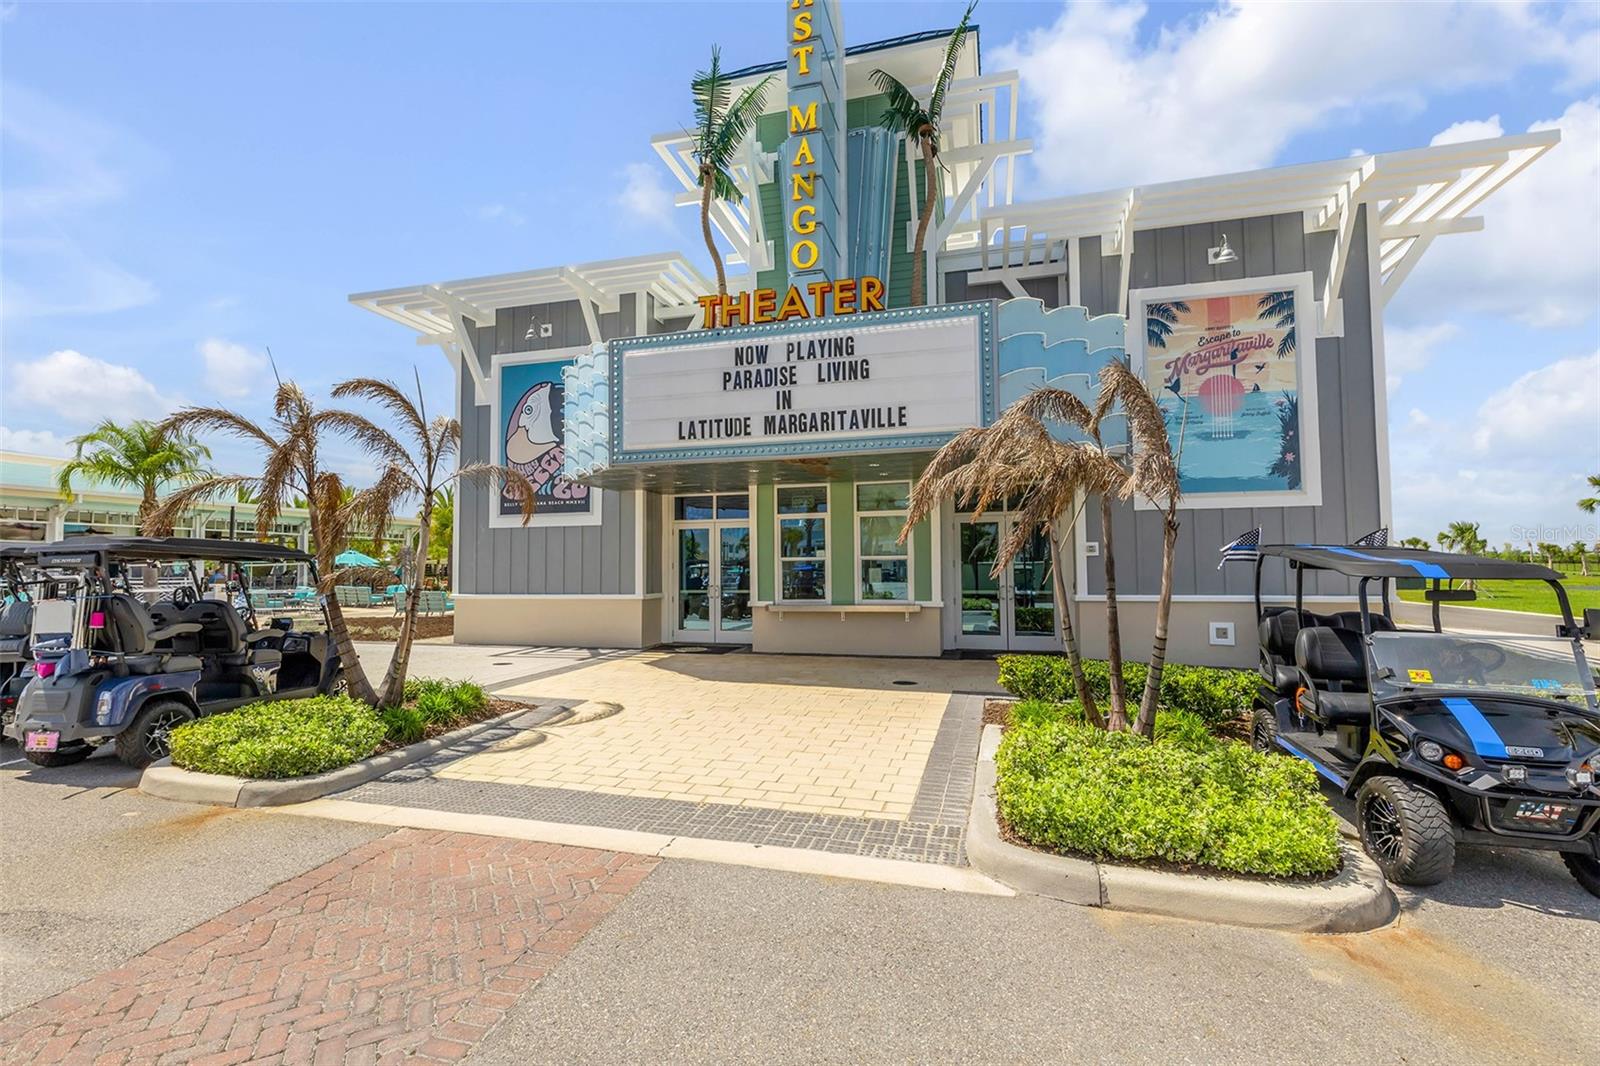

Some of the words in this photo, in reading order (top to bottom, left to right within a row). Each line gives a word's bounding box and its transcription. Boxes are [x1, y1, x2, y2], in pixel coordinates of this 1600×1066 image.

[789, 101, 819, 270] MANGO
[698, 276, 886, 329] THEATER
[734, 344, 769, 366] NOW
[786, 336, 855, 362] PLAYING
[1198, 331, 1232, 347] Escape
[1232, 329, 1241, 338] to
[723, 365, 797, 391] PARADISE
[817, 359, 870, 383] LIVING
[1164, 333, 1275, 384] Margaritaville
[776, 389, 792, 411] IN
[678, 417, 751, 440] LATITUDE
[764, 406, 907, 435] MARGARITAVILLE
